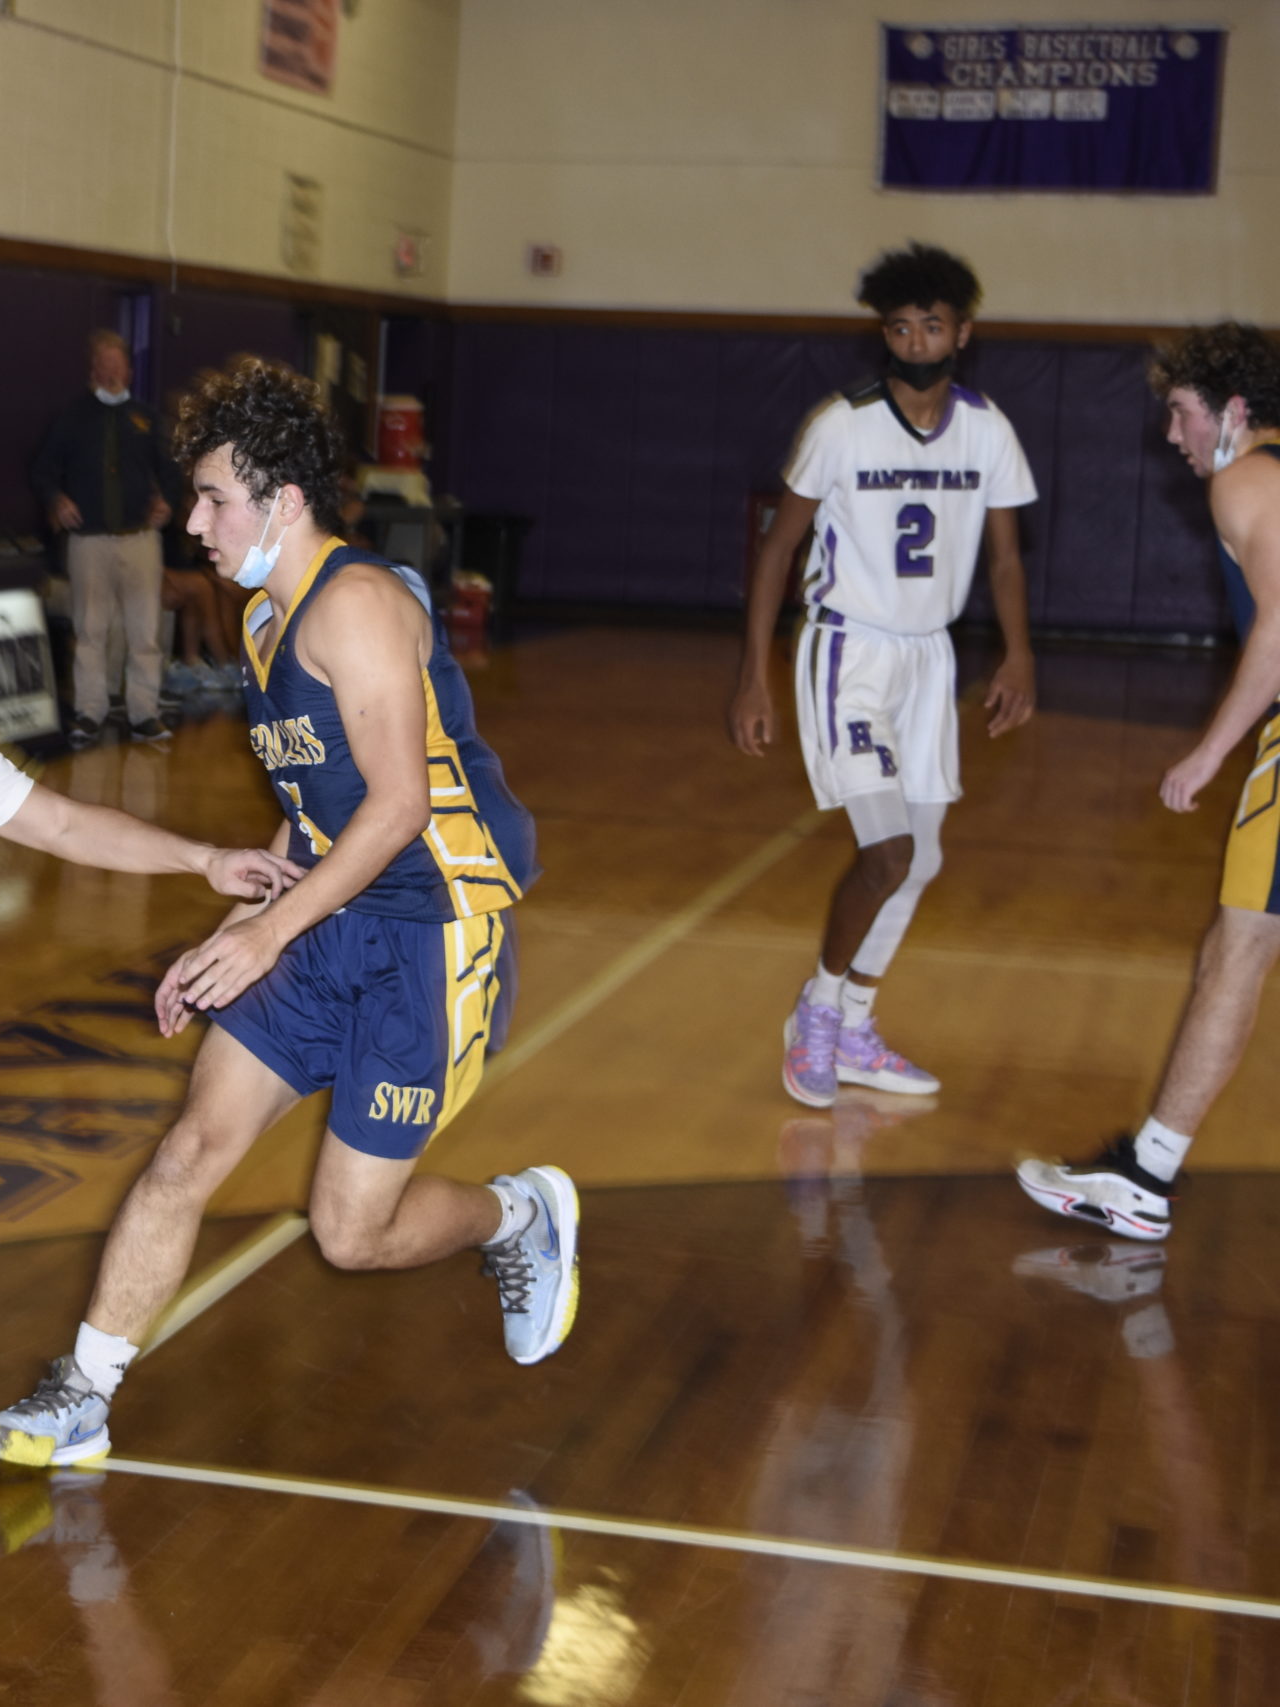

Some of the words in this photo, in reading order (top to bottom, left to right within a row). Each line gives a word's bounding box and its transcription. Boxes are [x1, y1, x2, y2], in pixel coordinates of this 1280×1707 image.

[943, 34, 1007, 60] GIRLS
[1023, 34, 1168, 60] BASKETBALL
[950, 61, 1158, 87] CHAMPIONS
[856, 469, 939, 491] HAMPTON
[941, 469, 981, 491] BAYS
[894, 503, 936, 578] 2
[368, 1081, 436, 1126] SWR
